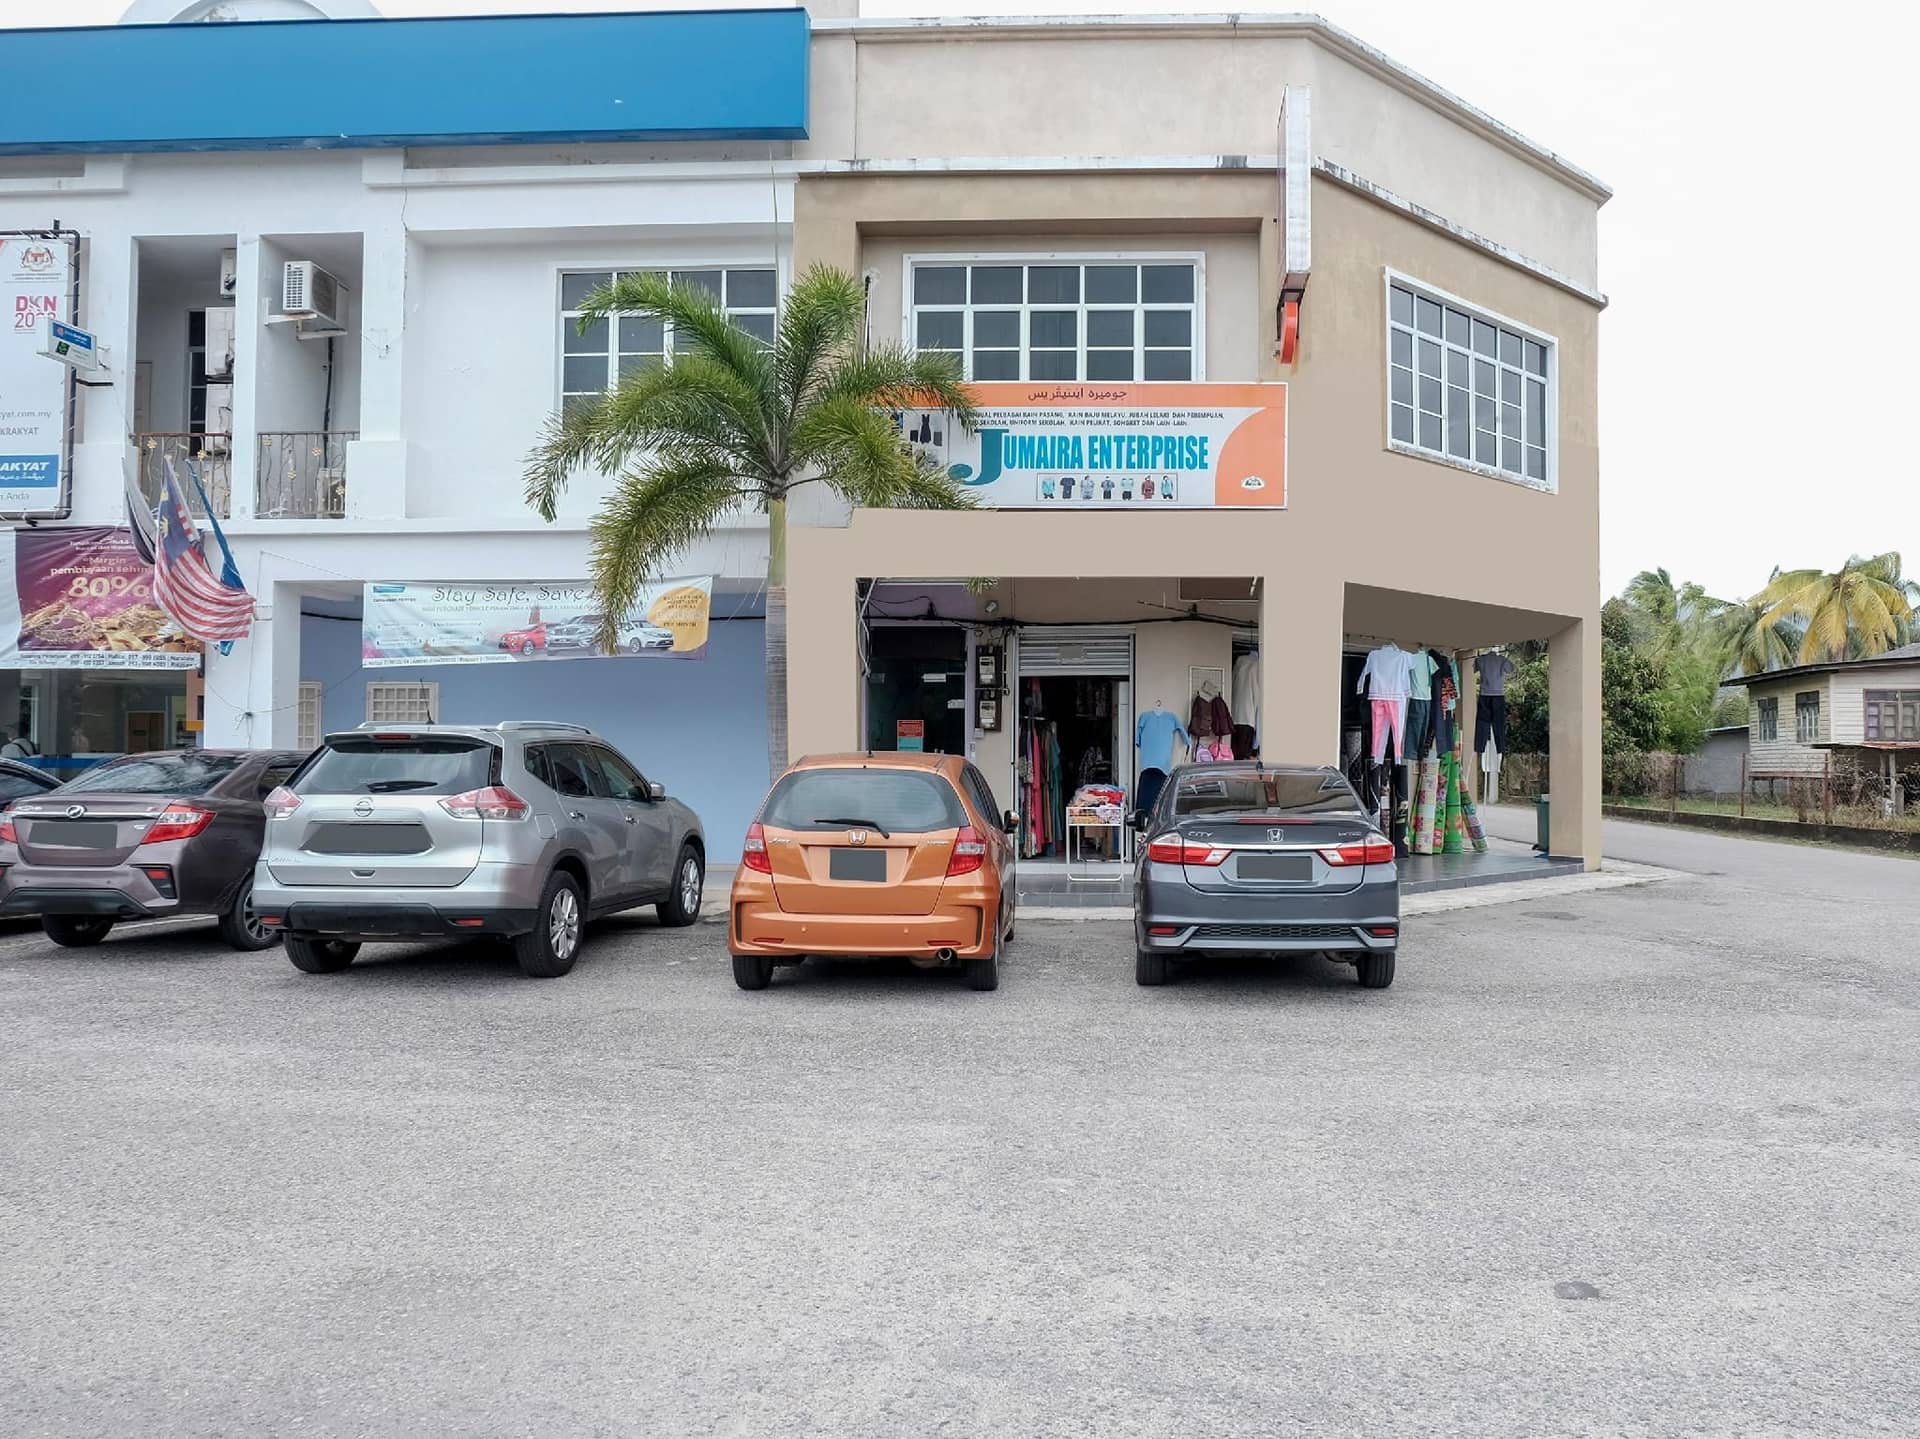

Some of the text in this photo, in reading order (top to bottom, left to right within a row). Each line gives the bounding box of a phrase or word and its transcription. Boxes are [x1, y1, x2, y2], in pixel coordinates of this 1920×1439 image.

[948, 428, 1209, 486] JUMAIRA ENTERPRISE
[68, 576, 150, 598] 80%
[432, 586, 477, 606] Stay
[536, 586, 585, 601] Save
